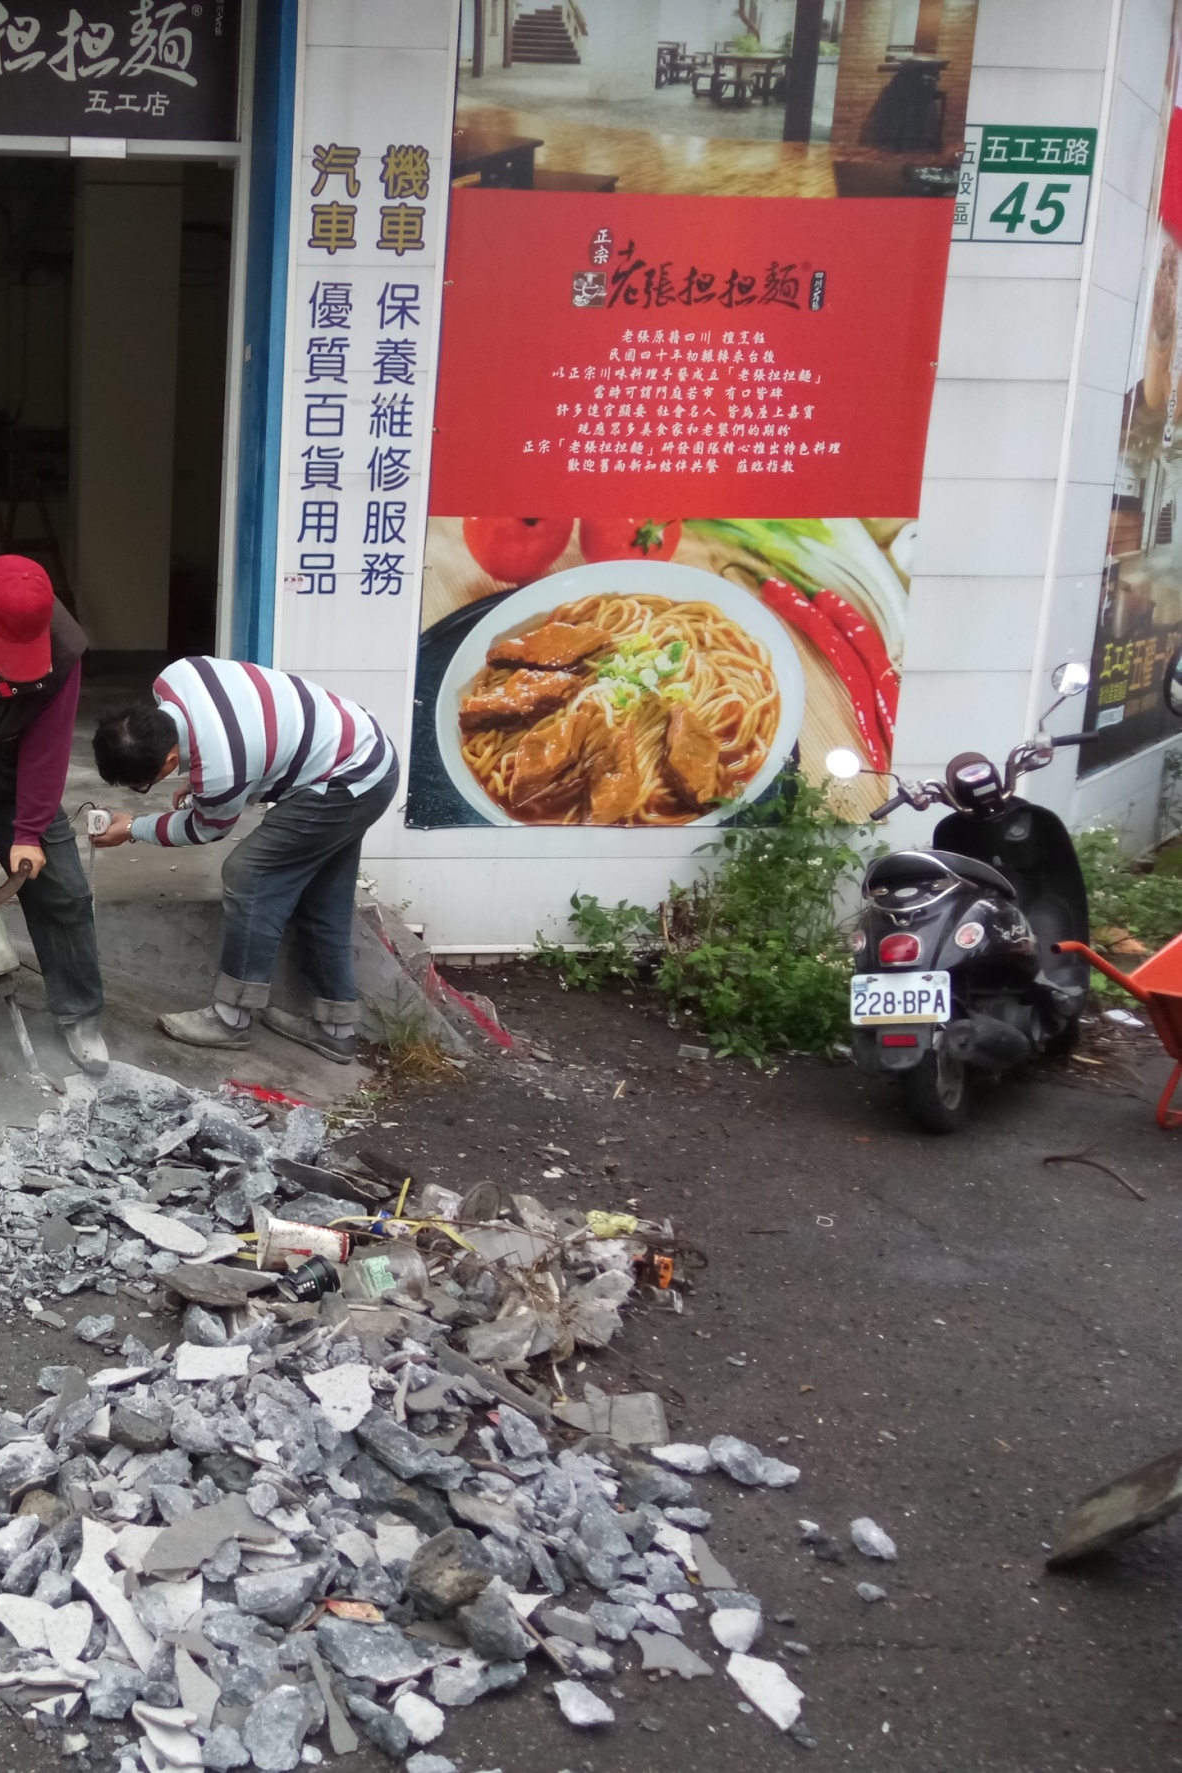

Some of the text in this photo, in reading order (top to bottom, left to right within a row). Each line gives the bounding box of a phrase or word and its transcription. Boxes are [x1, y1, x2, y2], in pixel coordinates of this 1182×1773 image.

[84, 90, 170, 116] 五工店
[983, 136, 1090, 166] 五工五路
[989, 181, 1072, 235] 45
[593, 229, 612, 264] 正宗
[607, 239, 802, 310] 老張担担麵
[622, 329, 765, 345] 老張原籍四川 擅烹飪
[297, 143, 361, 595] 汽車 優質百貨用品
[609, 348, 775, 364] 民國四十年初輾轉來台後
[360, 144, 430, 597] 機車 保養維修服務
[594, 384, 784, 400] 當時可謂門庭若市 有口皆碑
[556, 403, 815, 420] 許多達官顯要 社會名人 皆為座上嘉賓
[737, 459, 795, 473] 蒞臨指教
